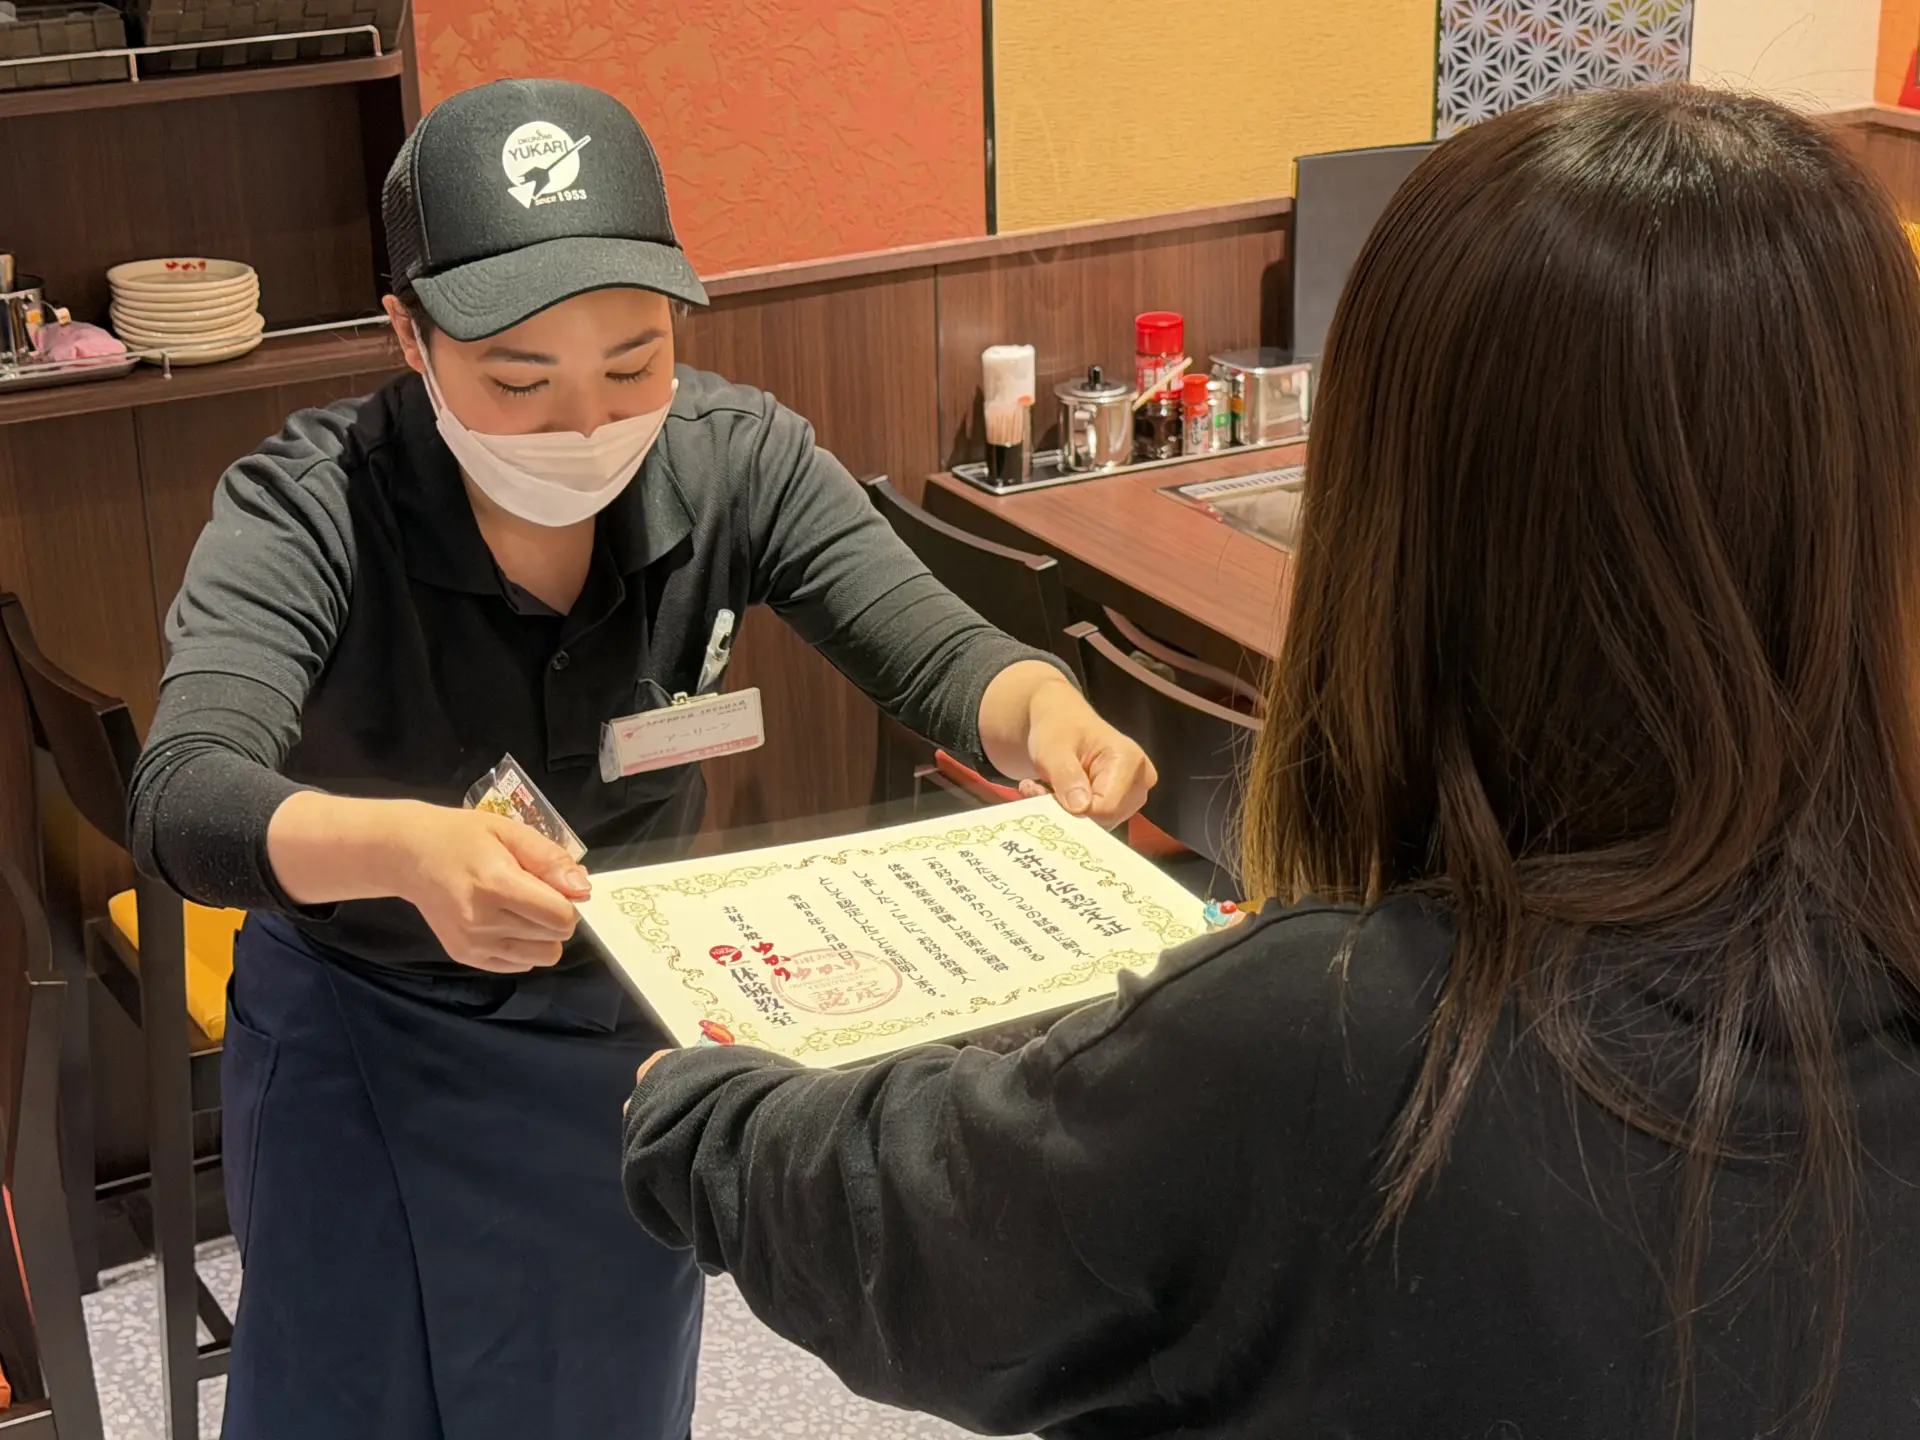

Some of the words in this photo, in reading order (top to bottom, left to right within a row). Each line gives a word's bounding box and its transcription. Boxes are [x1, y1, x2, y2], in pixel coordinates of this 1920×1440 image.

[508, 140, 568, 161] YUKARI
[556, 189, 588, 202] 1953
[787, 894, 854, 960] 令和8年2月18日
[888, 863, 1009, 973] 体験教室を受講し技術を習得
[922, 856, 1045, 962] 「お好み焼ゆかり」が主催する
[999, 840, 1131, 937] 免許皆伝認定証
[818, 876, 947, 998] として認定したことを証明します。
[730, 967, 798, 1027] 体験教室
